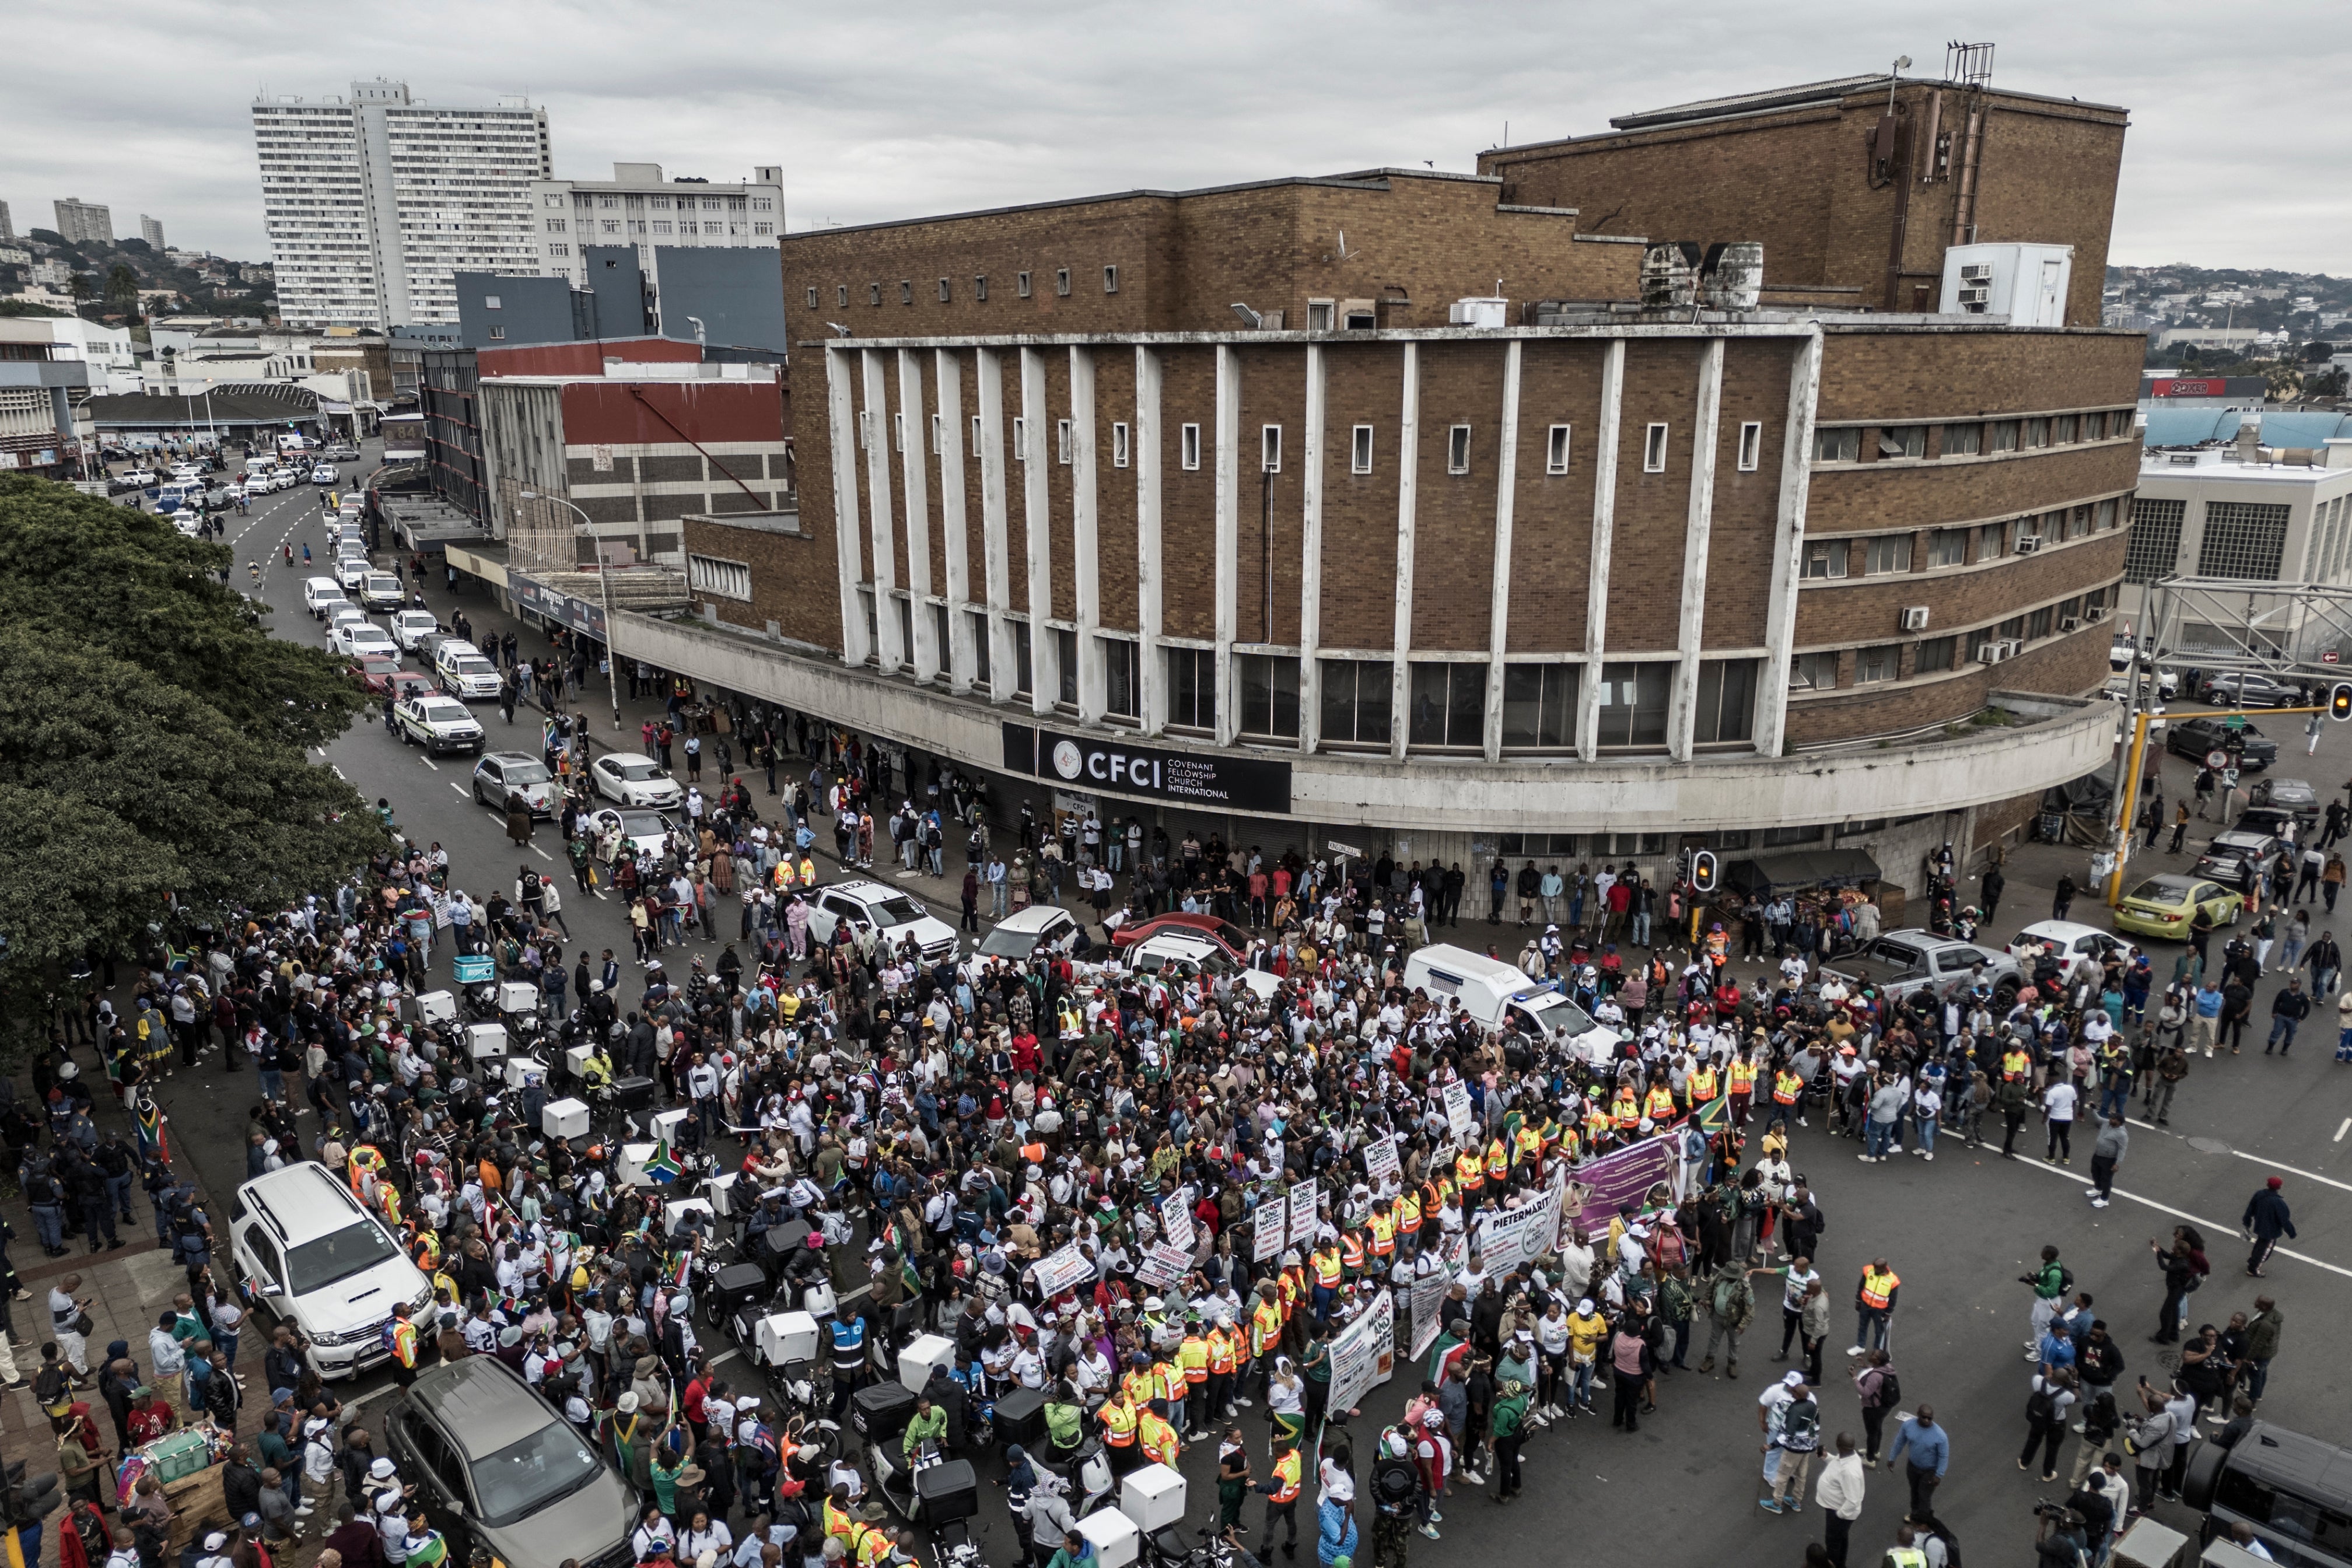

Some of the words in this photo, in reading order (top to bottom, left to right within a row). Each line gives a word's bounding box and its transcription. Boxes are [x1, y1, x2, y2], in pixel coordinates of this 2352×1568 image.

[2171, 381, 2208, 395] BOXER
[540, 587, 564, 606] progress
[573, 619, 589, 632] SAMSUNG
[1088, 752, 1161, 789] CFCI
[1168, 760, 1213, 771] COVENANT
[1168, 768, 1216, 779] FELLOWSHIP
[1168, 776, 1202, 787] CHURCH
[1168, 785, 1228, 799] INTERNATIONAL
[1073, 804, 1086, 813] CFCI
[1505, 1041, 1522, 1049] GAP
[1445, 1082, 1462, 1094] MARCH
[1367, 1138, 1391, 1153] MARCH
[1373, 1146, 1387, 1156] AND
[1434, 1147, 1453, 1157] MARCH
[1628, 1141, 1661, 1157] FOUNDATION
[1293, 1181, 1313, 1194] MARCH
[1165, 1191, 1182, 1209] MARCH
[1170, 1202, 1180, 1212] AND
[1259, 1200, 1282, 1214] MARCH
[1265, 1210, 1277, 1218] AND
[1527, 1220, 1546, 1235] MARCH
[1179, 1231, 1189, 1242] COUNTRY
[1526, 1231, 1545, 1247] MARCH
[1156, 1251, 1185, 1266] COMMUNITIES
[1170, 1249, 1188, 1259] MUSLIM
[1367, 1298, 1390, 1331] MARCH
[1374, 1318, 1390, 1335] AND
[1379, 1355, 1388, 1368] NO
[1340, 1375, 1352, 1388] TIME
